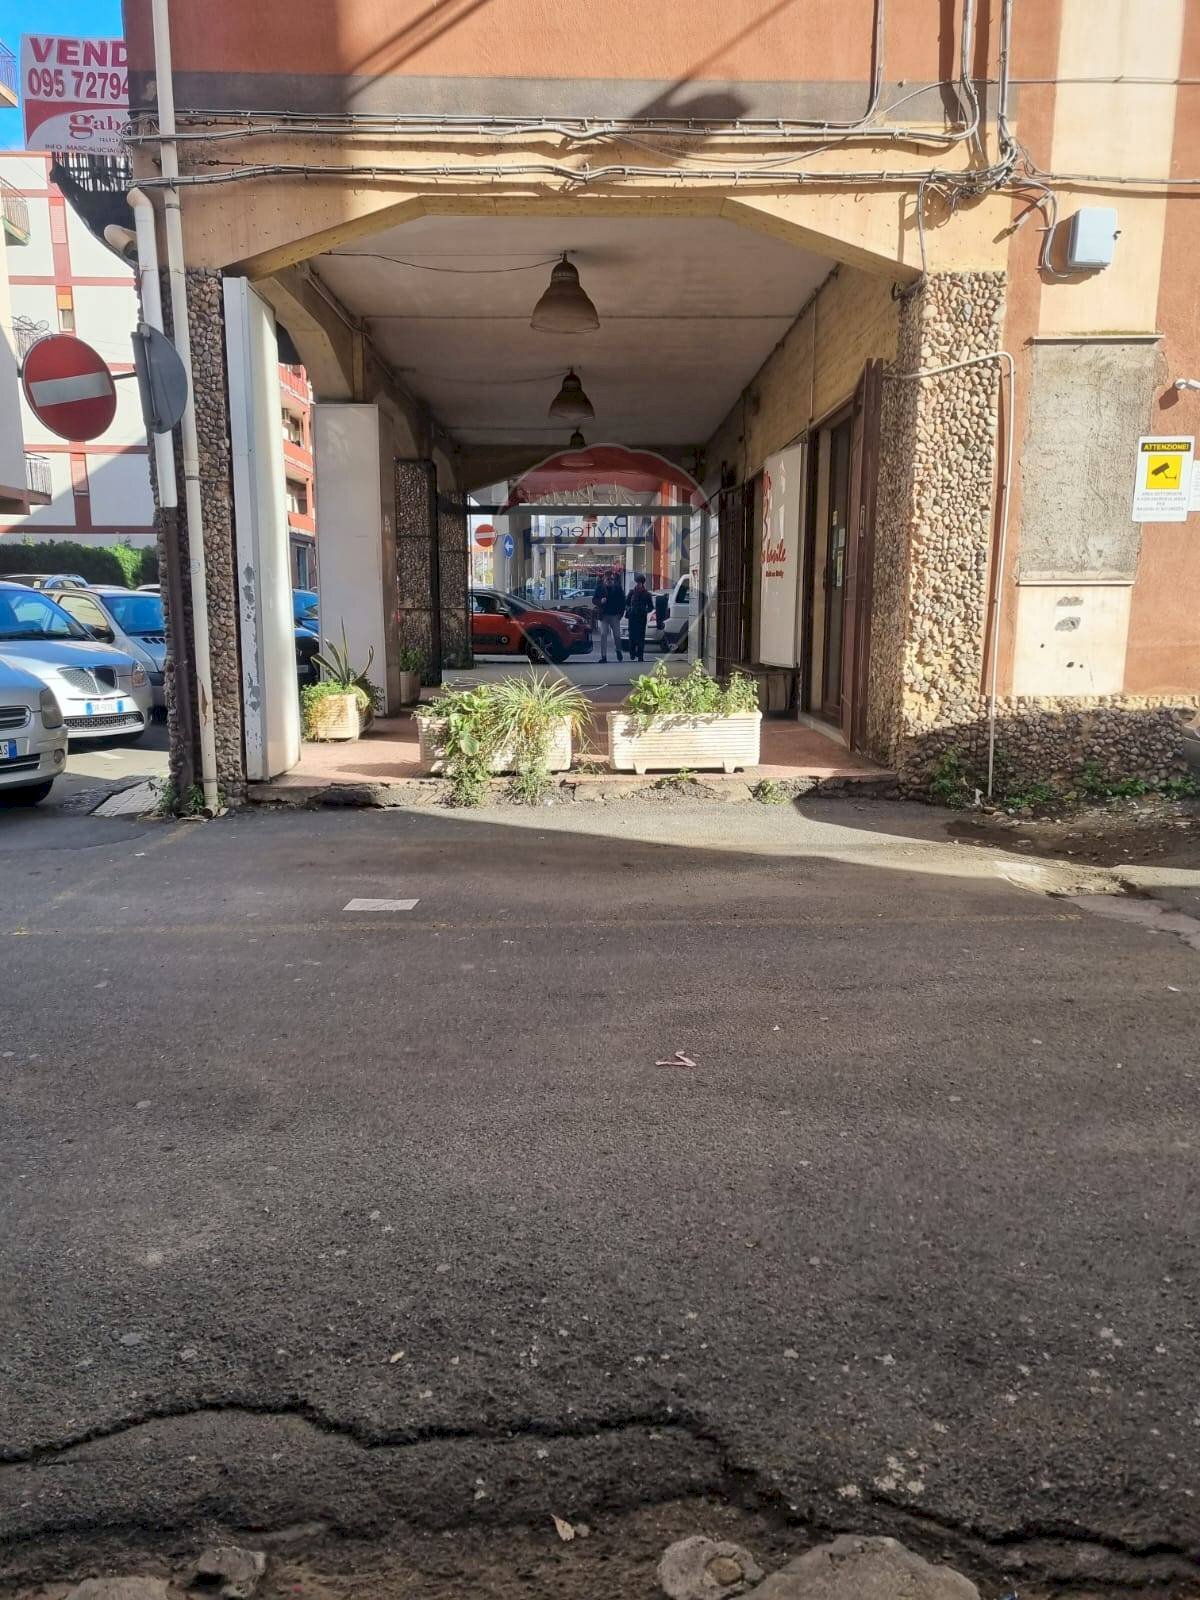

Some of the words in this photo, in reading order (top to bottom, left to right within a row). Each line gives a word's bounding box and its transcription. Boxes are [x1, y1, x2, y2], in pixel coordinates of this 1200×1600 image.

[30, 37, 128, 67] VEND
[28, 67, 66, 97] 095
[69, 113, 126, 139] gab
[1143, 443, 1189, 451] ATTENZIONE!
